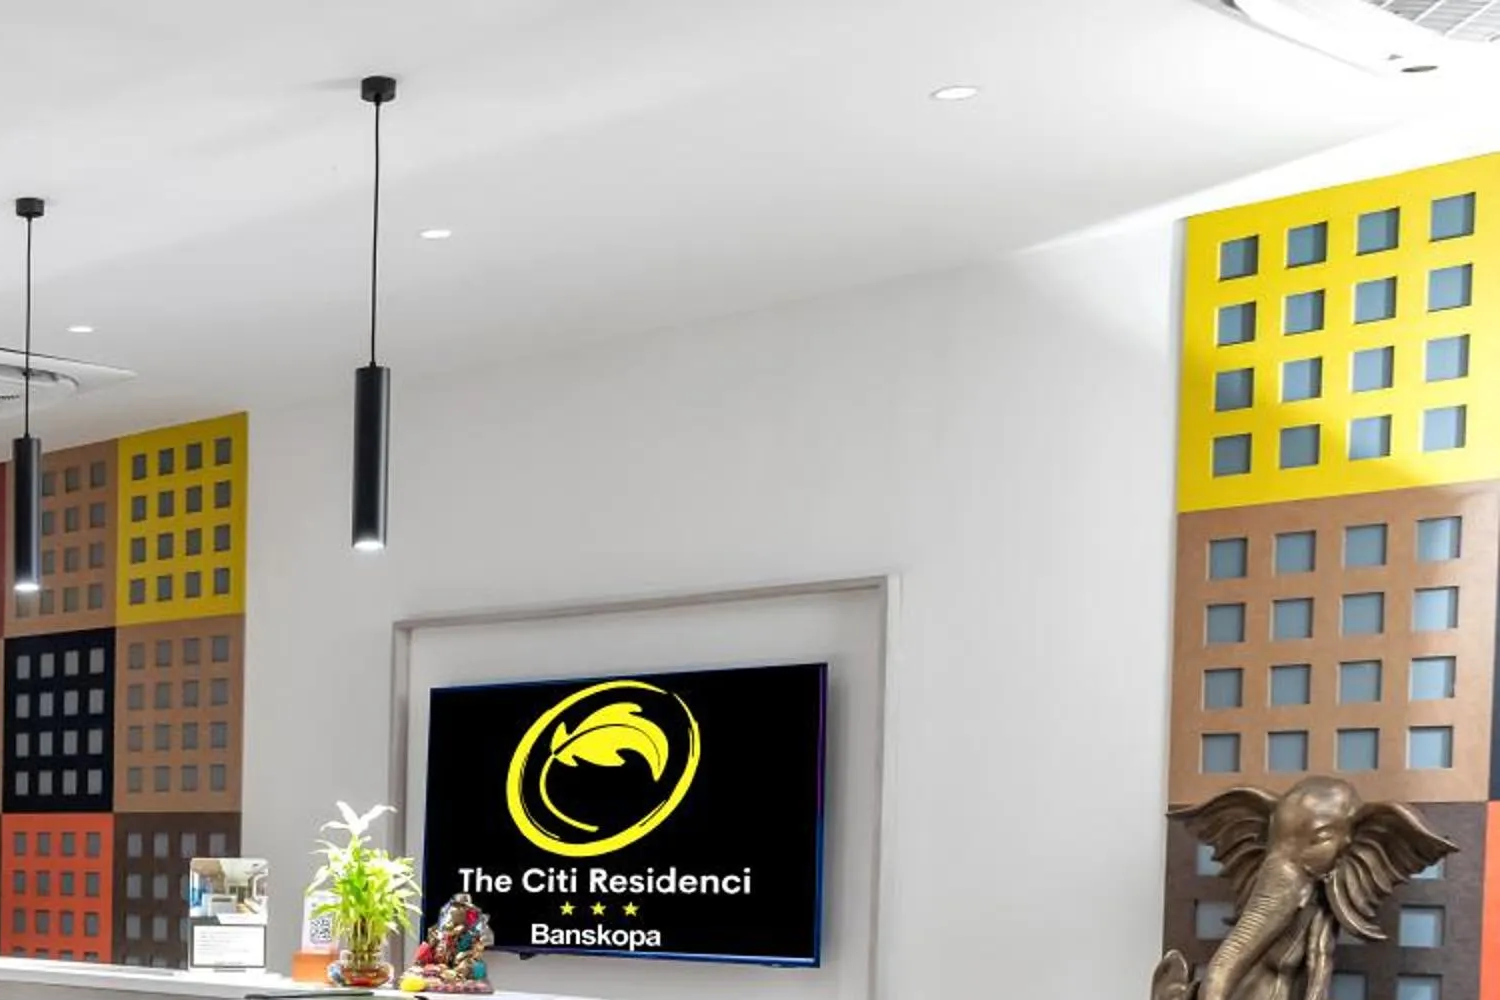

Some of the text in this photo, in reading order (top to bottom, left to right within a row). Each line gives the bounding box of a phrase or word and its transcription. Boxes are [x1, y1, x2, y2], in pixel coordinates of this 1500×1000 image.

[458, 866, 751, 894] The Citi Residenci
[531, 923, 661, 951] Banskopa
